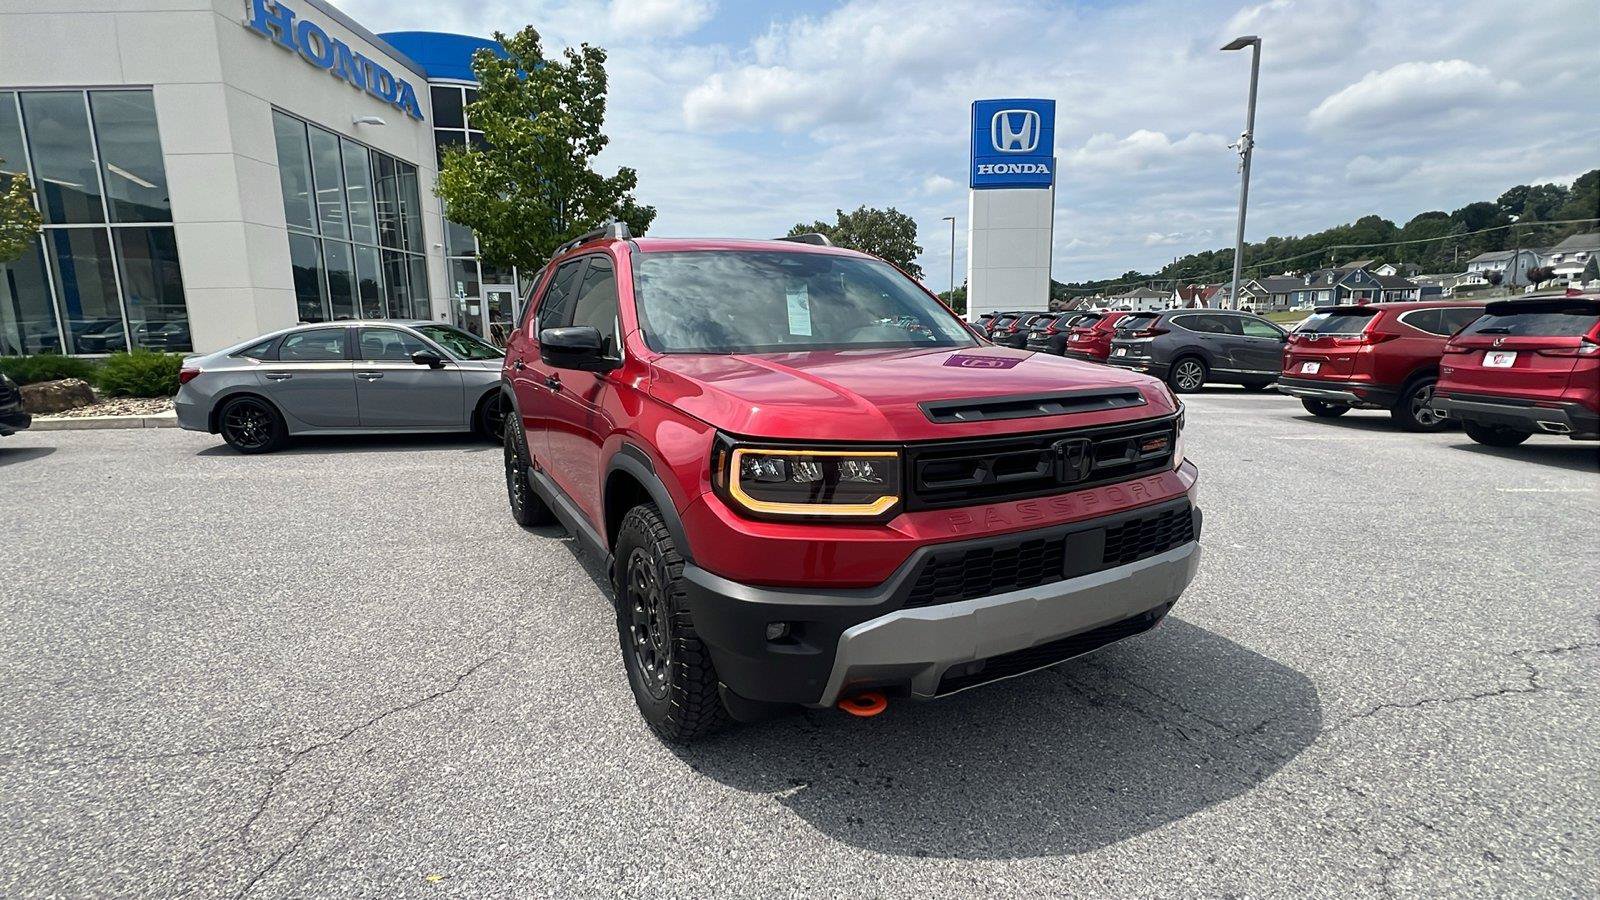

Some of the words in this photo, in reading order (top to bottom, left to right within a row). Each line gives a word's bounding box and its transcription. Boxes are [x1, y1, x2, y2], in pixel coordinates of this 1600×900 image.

[243, 0, 424, 121] HONDA
[978, 164, 1050, 174] HONDA
[949, 476, 1167, 533] PASSPORT
